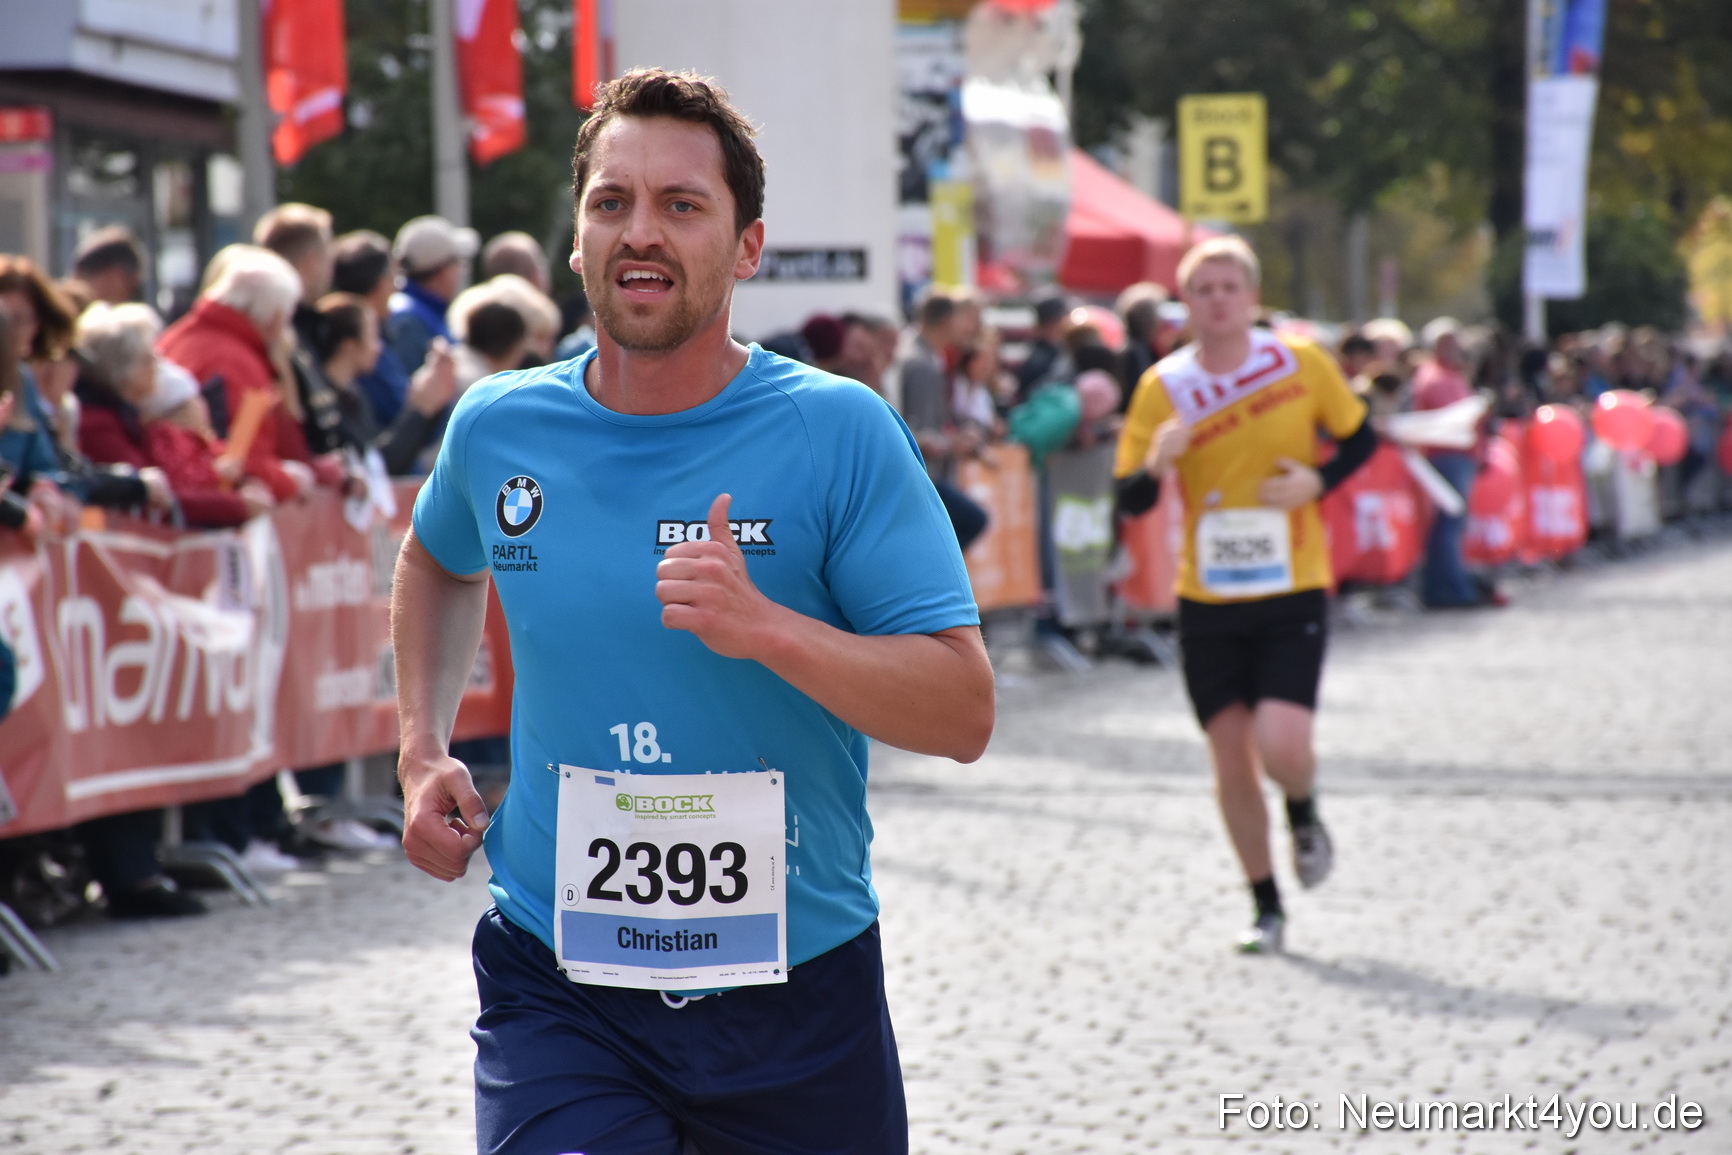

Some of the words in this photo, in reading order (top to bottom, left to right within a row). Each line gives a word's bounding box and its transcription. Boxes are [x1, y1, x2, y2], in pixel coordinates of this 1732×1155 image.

[1203, 135, 1242, 193] B
[501, 477, 540, 499] BMW
[492, 545, 538, 560] PARTL
[493, 561, 538, 572] Neumarkt
[609, 721, 672, 763] 18.
[634, 794, 715, 813] BOCK
[586, 838, 749, 906] 2393
[566, 890, 574, 901] D
[617, 926, 718, 952] Christian
